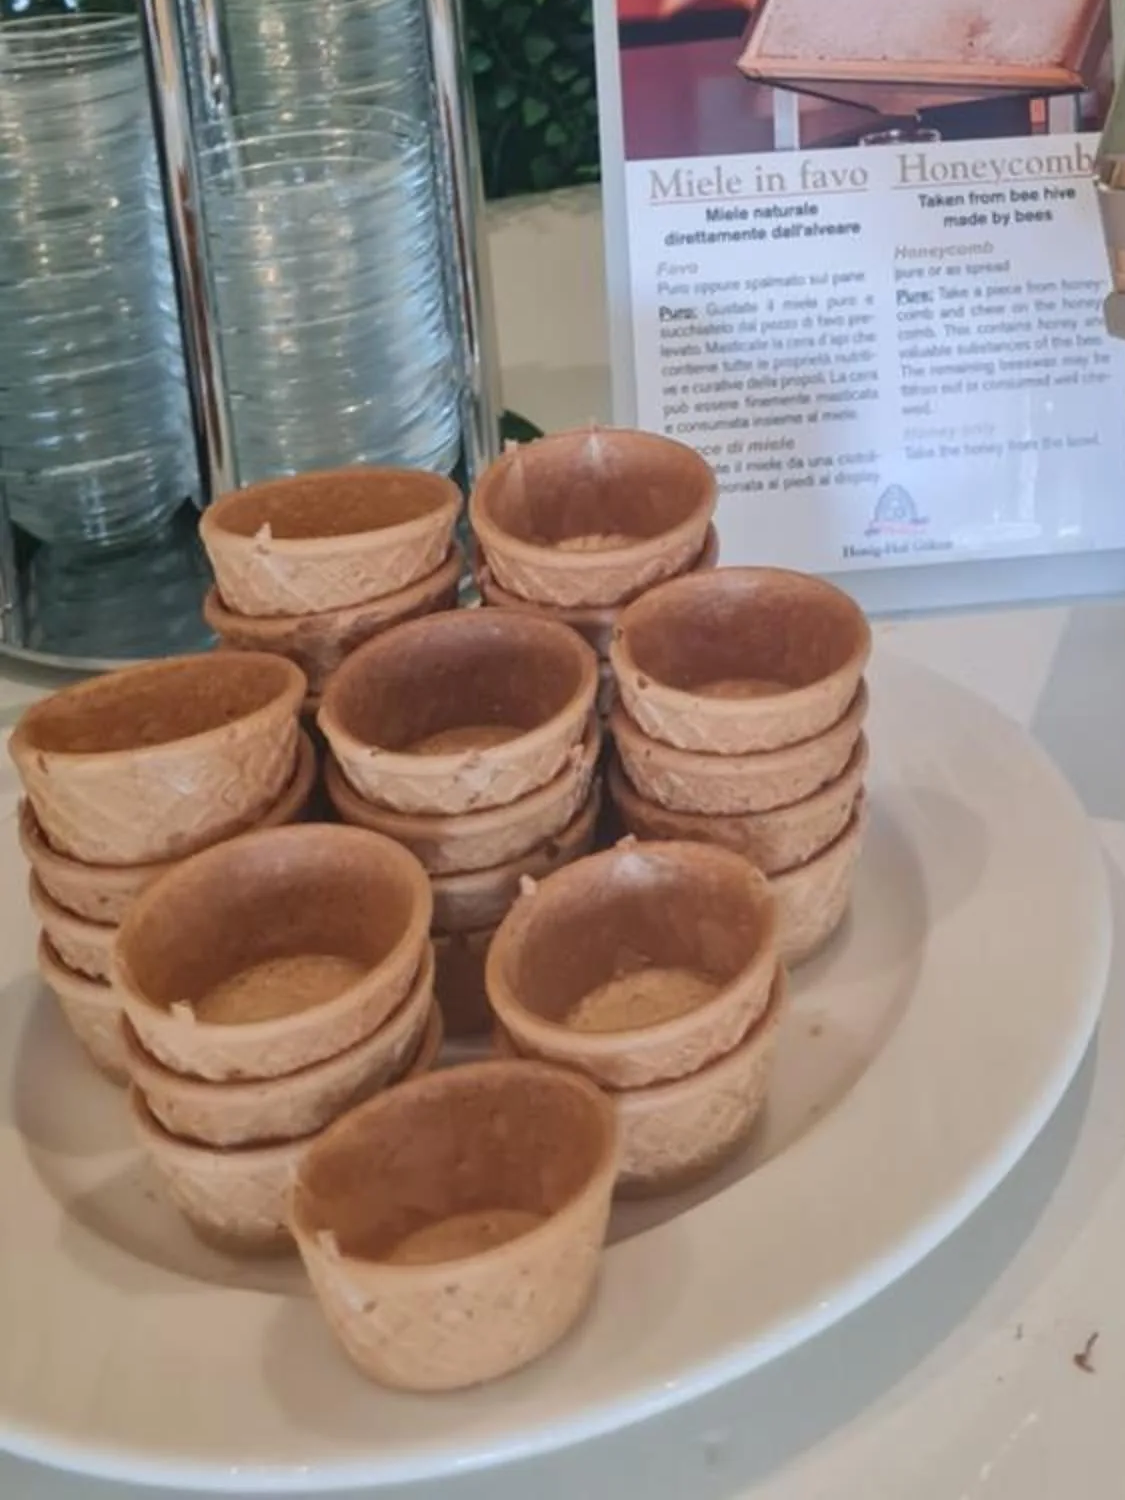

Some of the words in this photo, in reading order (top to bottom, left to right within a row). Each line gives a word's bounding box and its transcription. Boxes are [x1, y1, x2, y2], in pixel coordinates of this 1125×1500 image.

[896, 141, 1096, 184] Honeycomb
[649, 165, 743, 200] Miele
[755, 164, 785, 193] in
[800, 158, 869, 190] favo
[918, 192, 964, 208] Taken
[968, 190, 1005, 206] from
[1010, 188, 1039, 202] bee
[1044, 185, 1076, 200] hive
[705, 206, 749, 222] Miele
[753, 203, 819, 220] naturale
[943, 212, 987, 228] made
[992, 211, 1011, 228] by
[1015, 208, 1053, 223] bees
[664, 227, 767, 246] direttamente
[894, 240, 995, 260] Honeycomb
